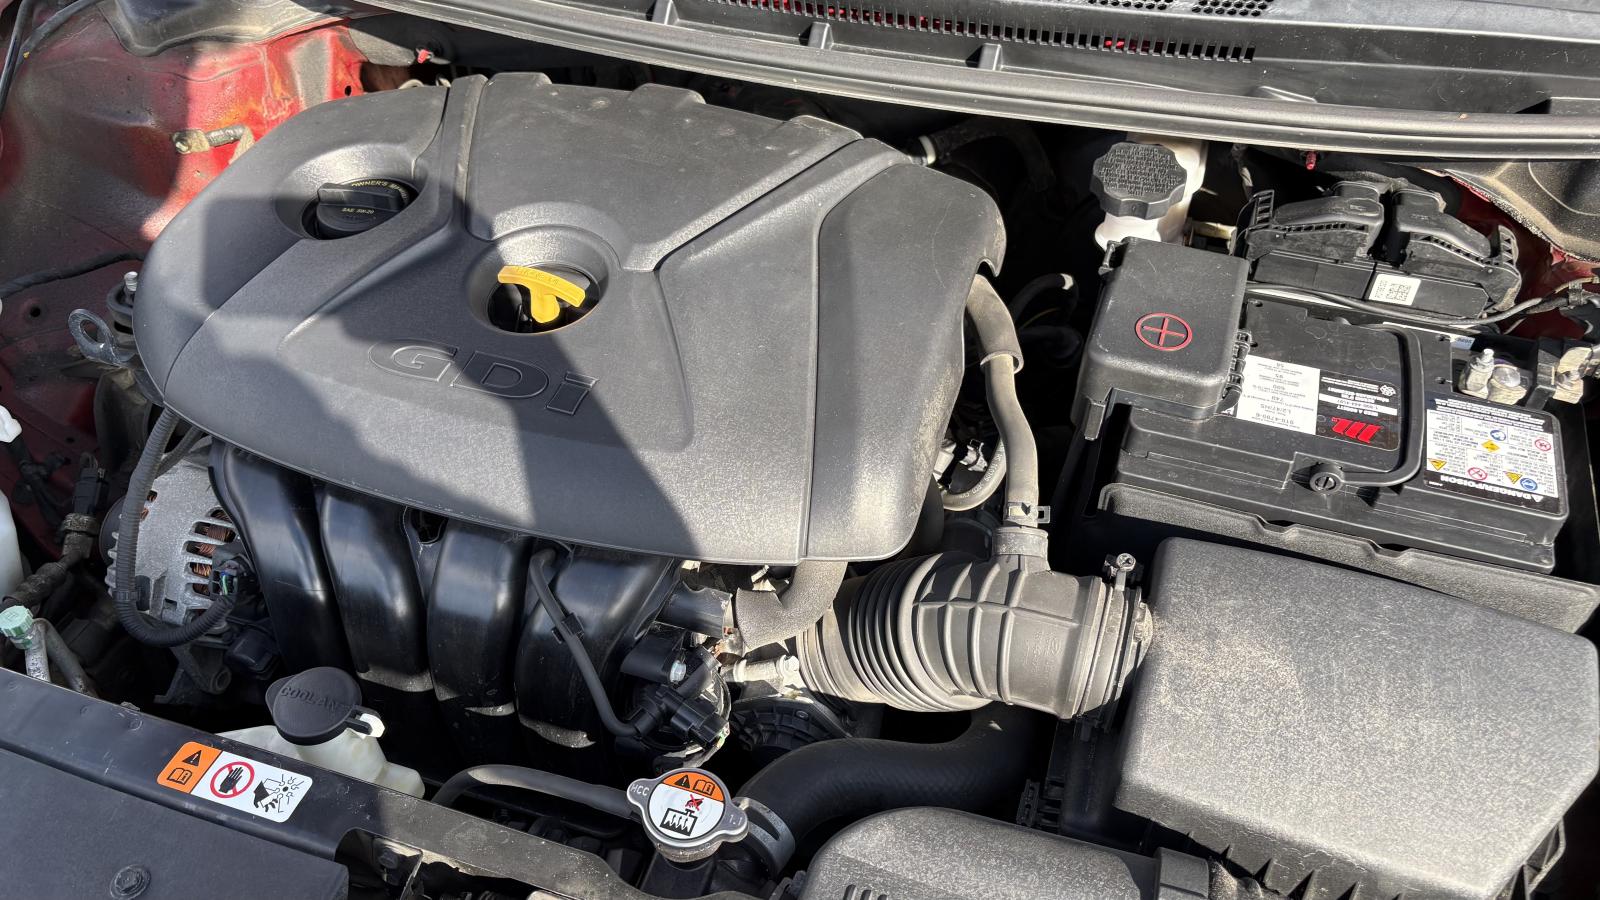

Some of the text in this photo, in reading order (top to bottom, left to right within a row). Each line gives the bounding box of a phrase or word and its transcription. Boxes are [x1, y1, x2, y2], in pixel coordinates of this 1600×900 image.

[368, 338, 599, 415] GDi
[1440, 475, 1532, 500] DANGER/POISON
[280, 686, 341, 711] COOLAN
[630, 784, 650, 797] HCC
